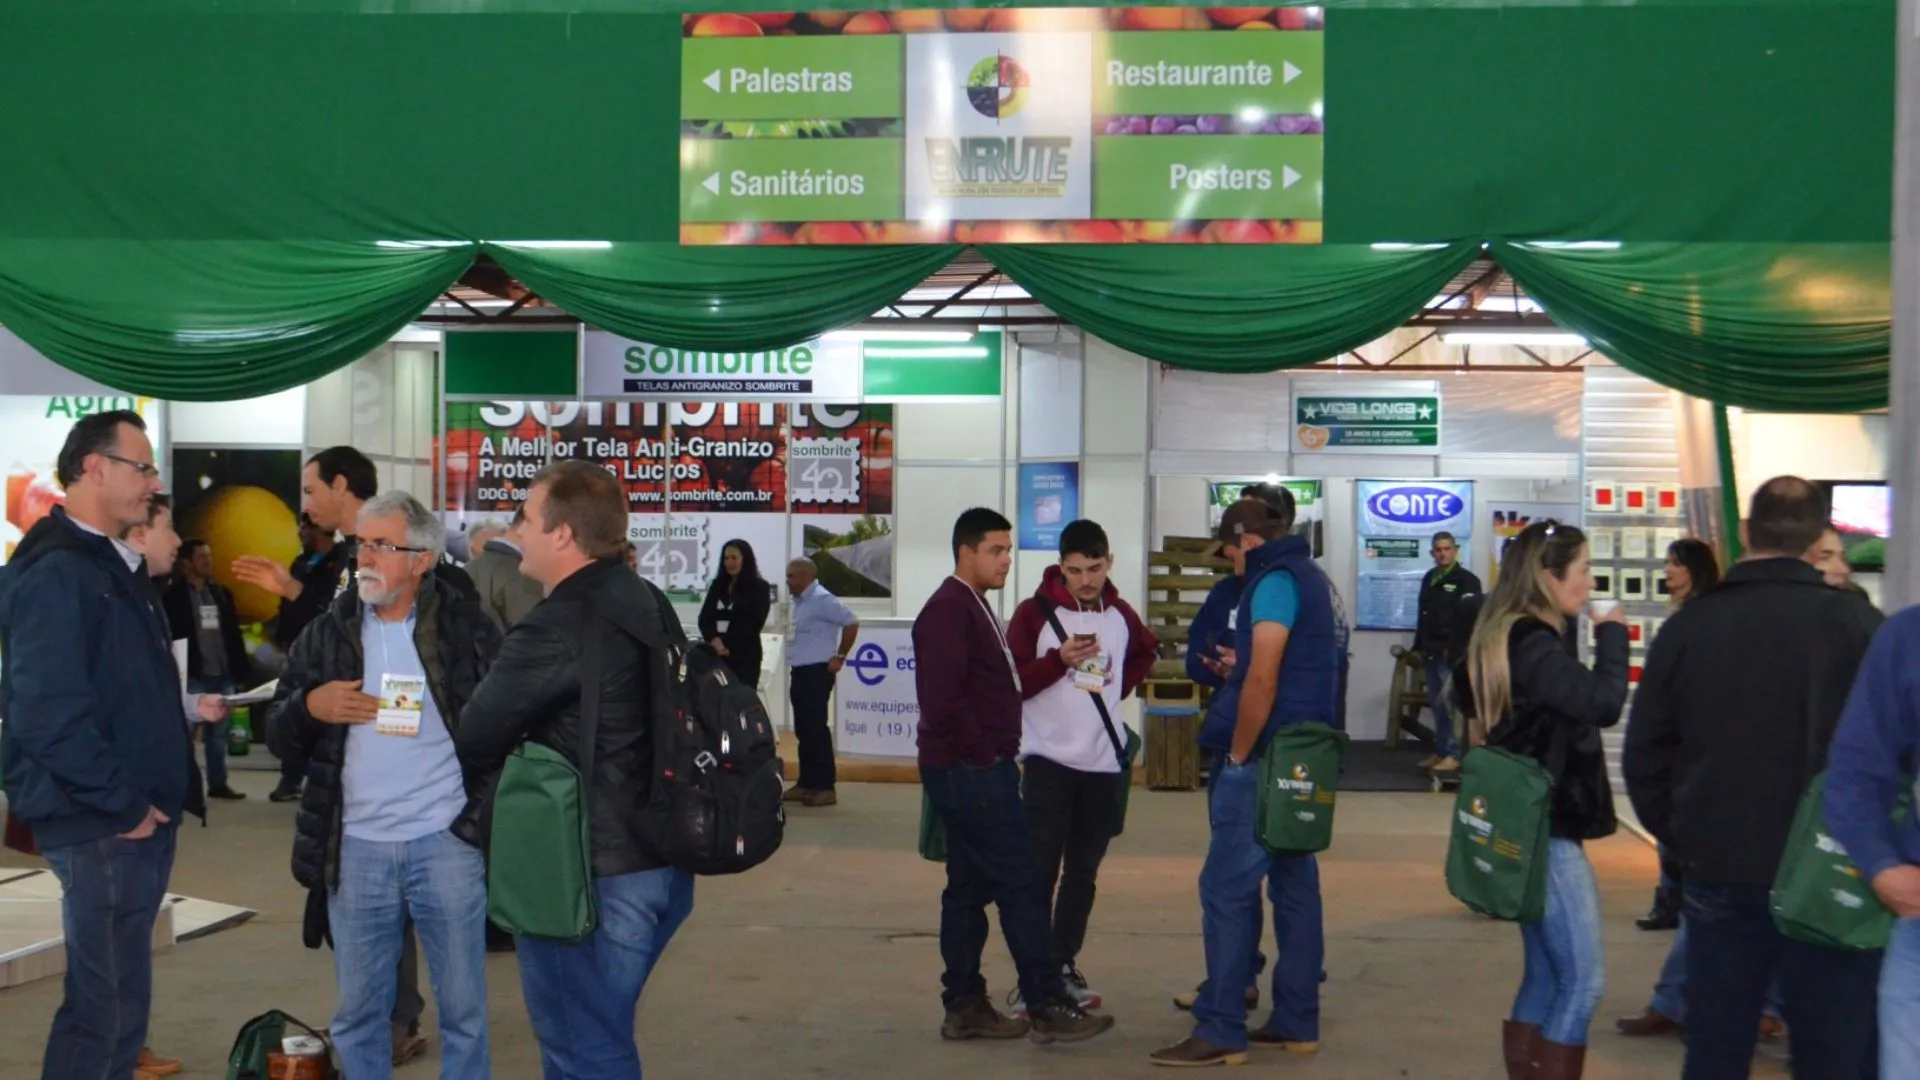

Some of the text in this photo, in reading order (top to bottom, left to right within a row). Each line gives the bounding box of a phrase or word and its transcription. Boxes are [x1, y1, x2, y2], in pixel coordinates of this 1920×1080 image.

[730, 68, 853, 93] Palestras
[1106, 60, 1272, 86] Restaurante
[925, 136, 1073, 182] ENFRUTE
[730, 169, 865, 196] Sanitários
[1169, 163, 1272, 190] Posters
[637, 381, 800, 391] TELAS ANTIGRANIZO SOMBRITE
[479, 437, 495, 457] A
[502, 437, 577, 457] Melhor
[582, 437, 628, 457] Tela
[792, 444, 852, 457] sombrite
[624, 459, 701, 481] Lucos
[478, 488, 508, 500] DDG
[1376, 494, 1452, 516] CONTE
[630, 524, 698, 538] sombrite
